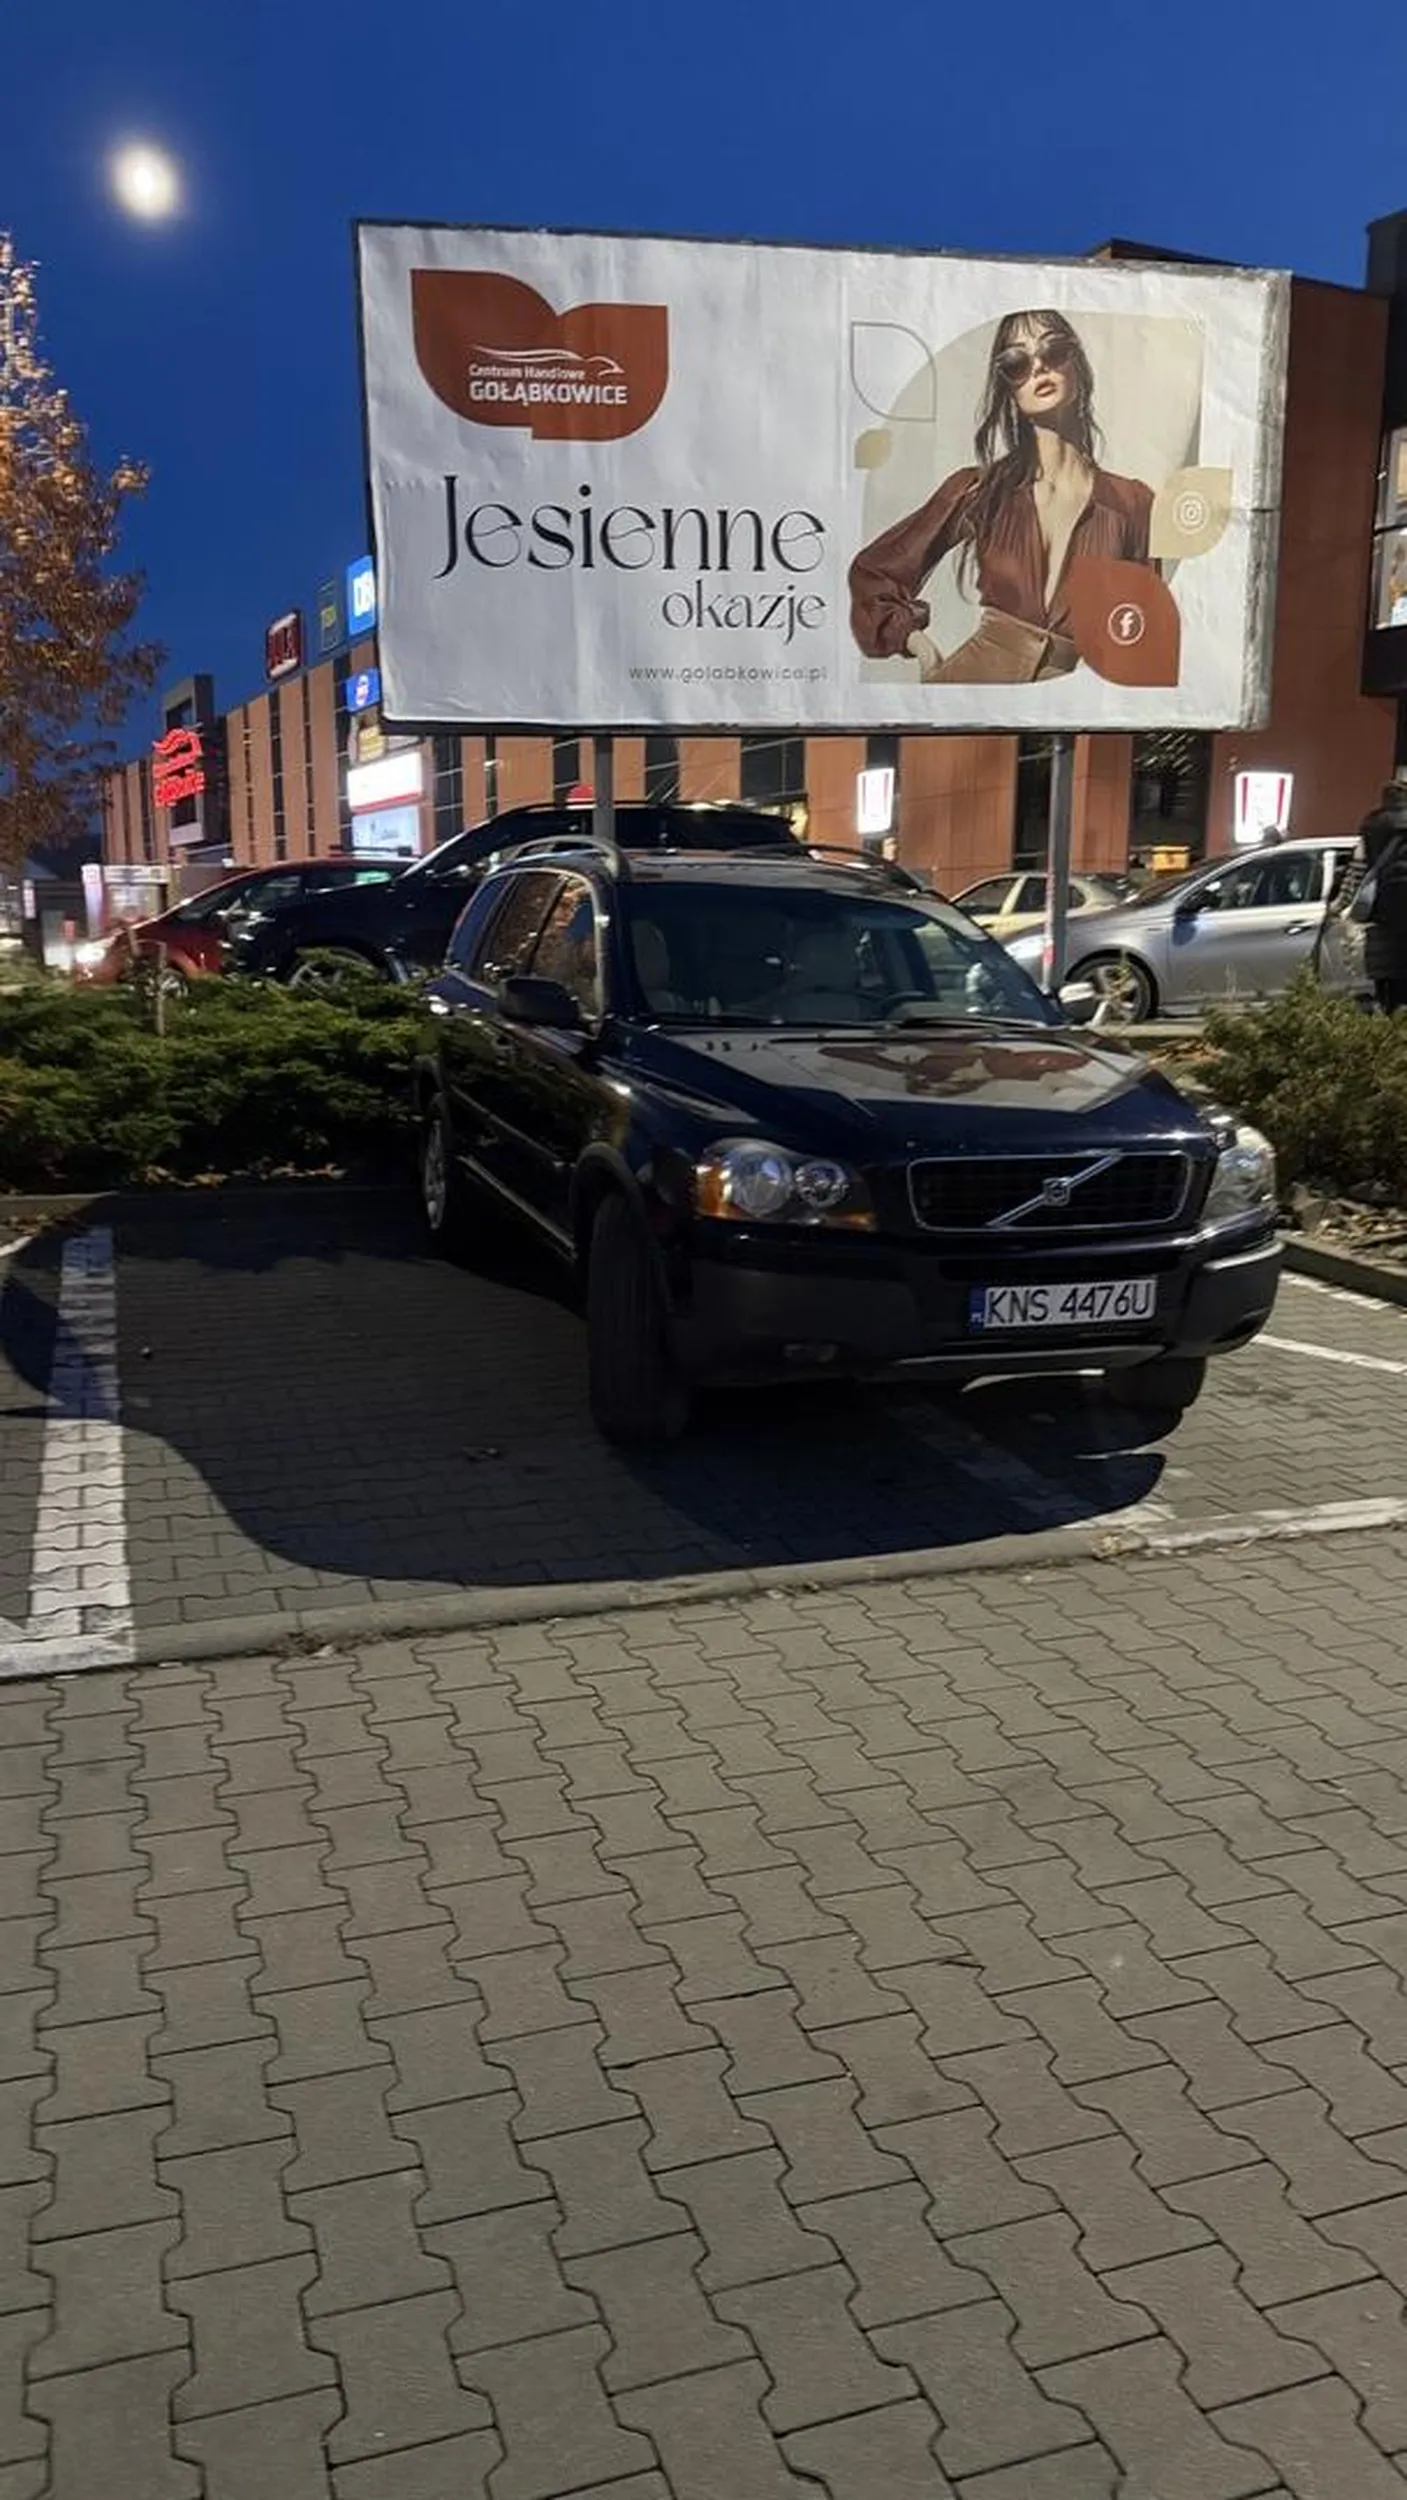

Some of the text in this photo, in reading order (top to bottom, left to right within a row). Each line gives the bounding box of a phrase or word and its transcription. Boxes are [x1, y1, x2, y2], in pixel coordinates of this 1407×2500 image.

[468, 363, 586, 380] Centrum Handlowe
[469, 380, 628, 407] GOŁĄBKOWICE
[432, 475, 827, 580] Jesienne
[661, 578, 828, 645] okazje
[986, 1283, 1151, 1325] KNS 4476U
